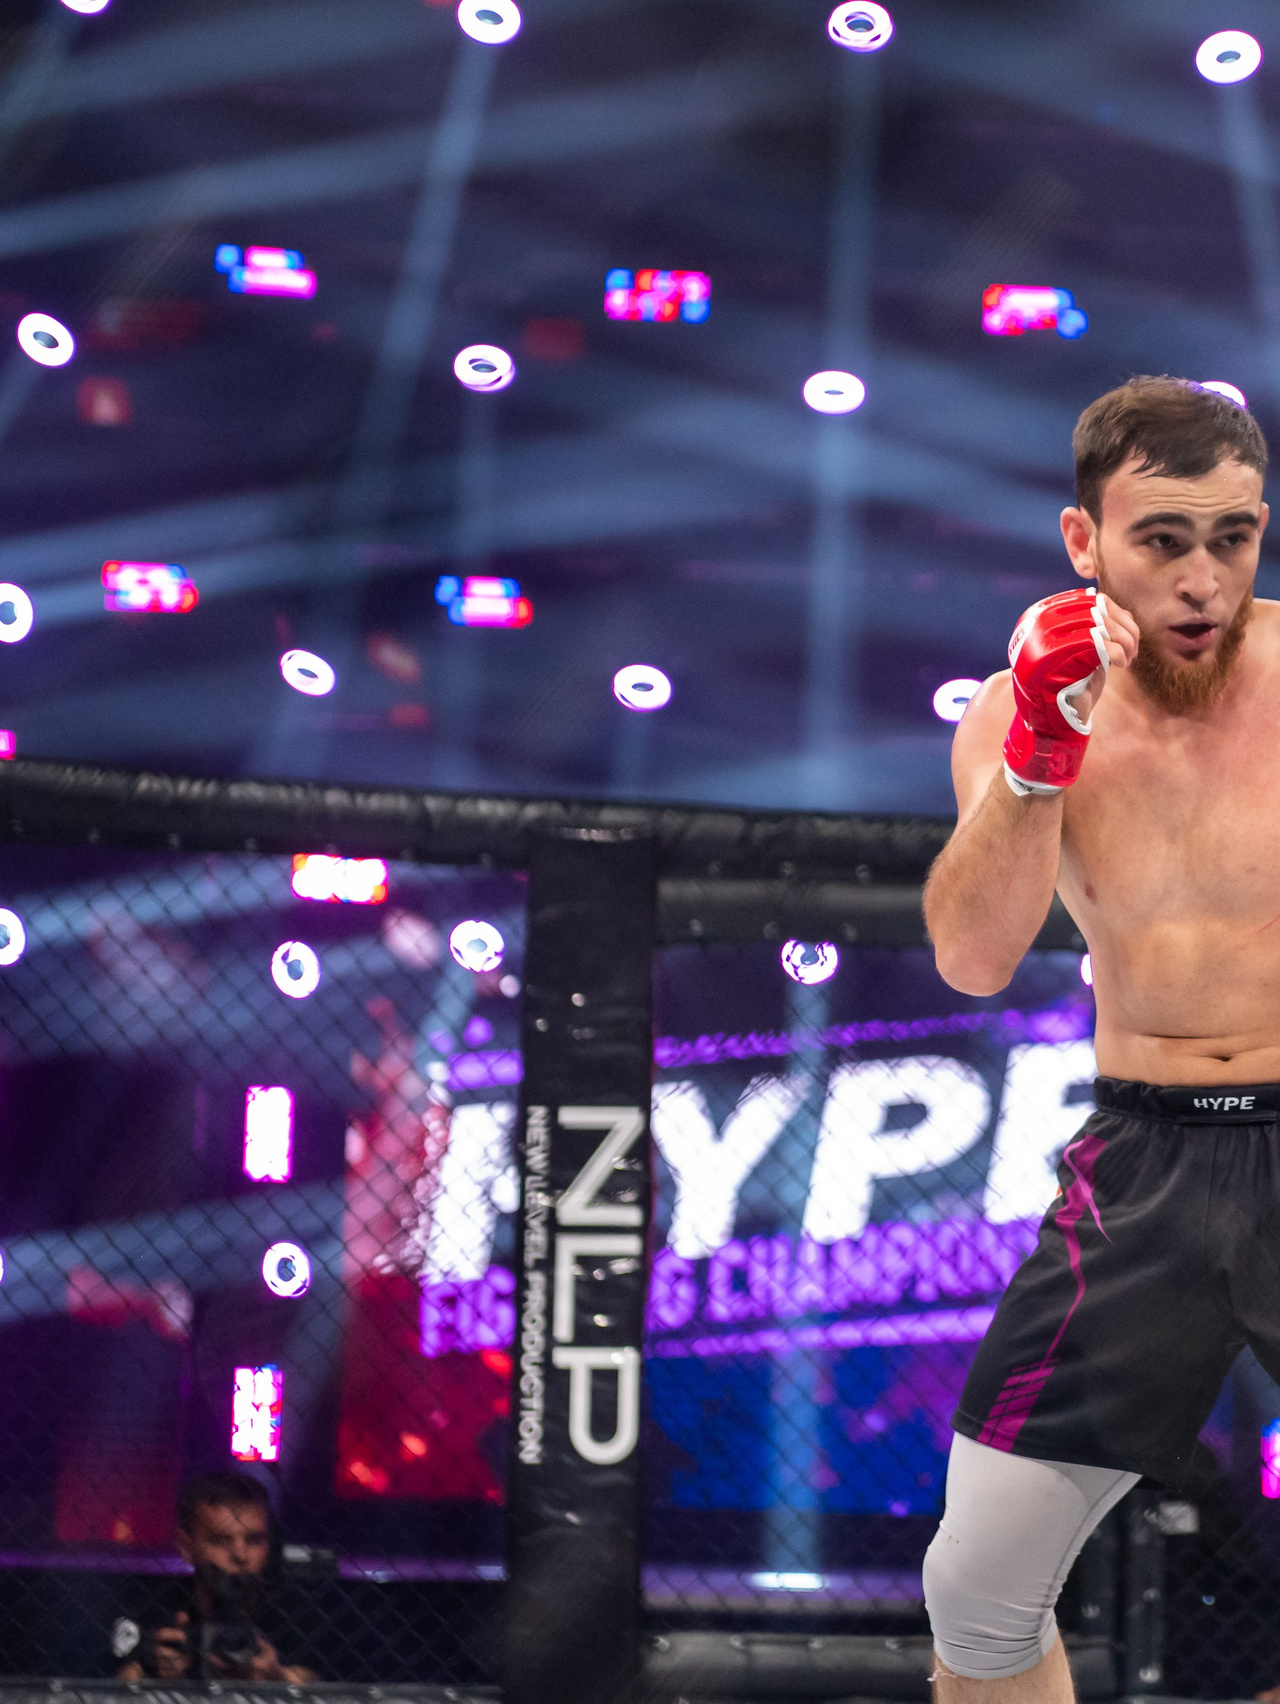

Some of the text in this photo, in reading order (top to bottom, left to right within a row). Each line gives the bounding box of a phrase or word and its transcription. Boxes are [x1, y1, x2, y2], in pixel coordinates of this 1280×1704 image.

[1193, 1096, 1256, 1111] HYPE
[518, 1105, 549, 1465] NEW LEVEL PRODUCTION
[552, 1106, 645, 1465] NLP
